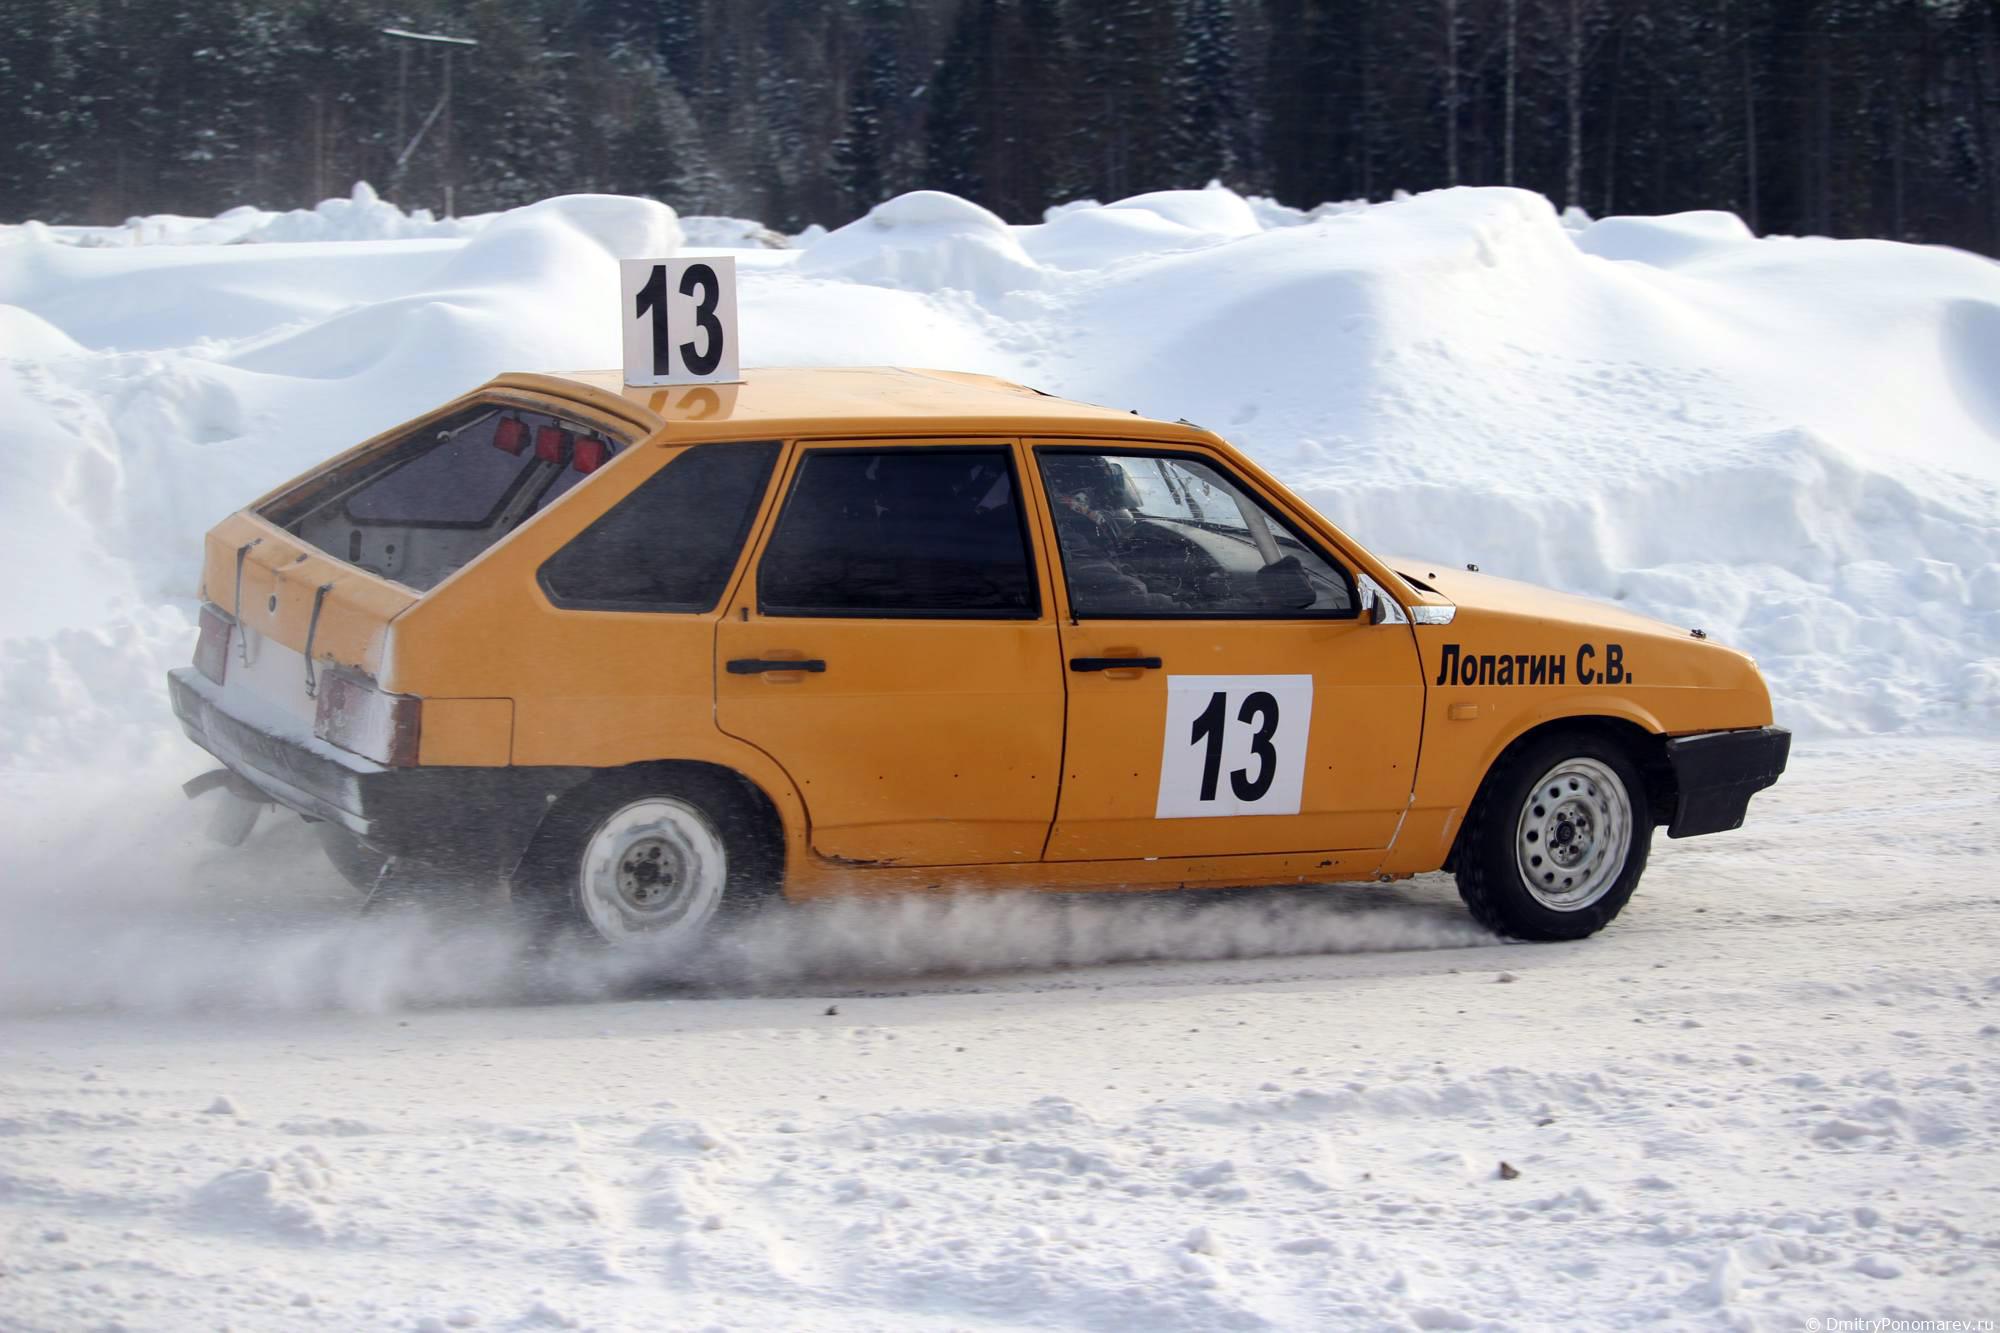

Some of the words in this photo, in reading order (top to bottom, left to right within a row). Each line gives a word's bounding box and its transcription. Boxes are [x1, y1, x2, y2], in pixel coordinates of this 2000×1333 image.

[636, 263, 724, 376] 13
[1436, 643, 1566, 686] Лопатин
[1576, 643, 1632, 685] С.В.
[1190, 691, 1280, 802] 13
